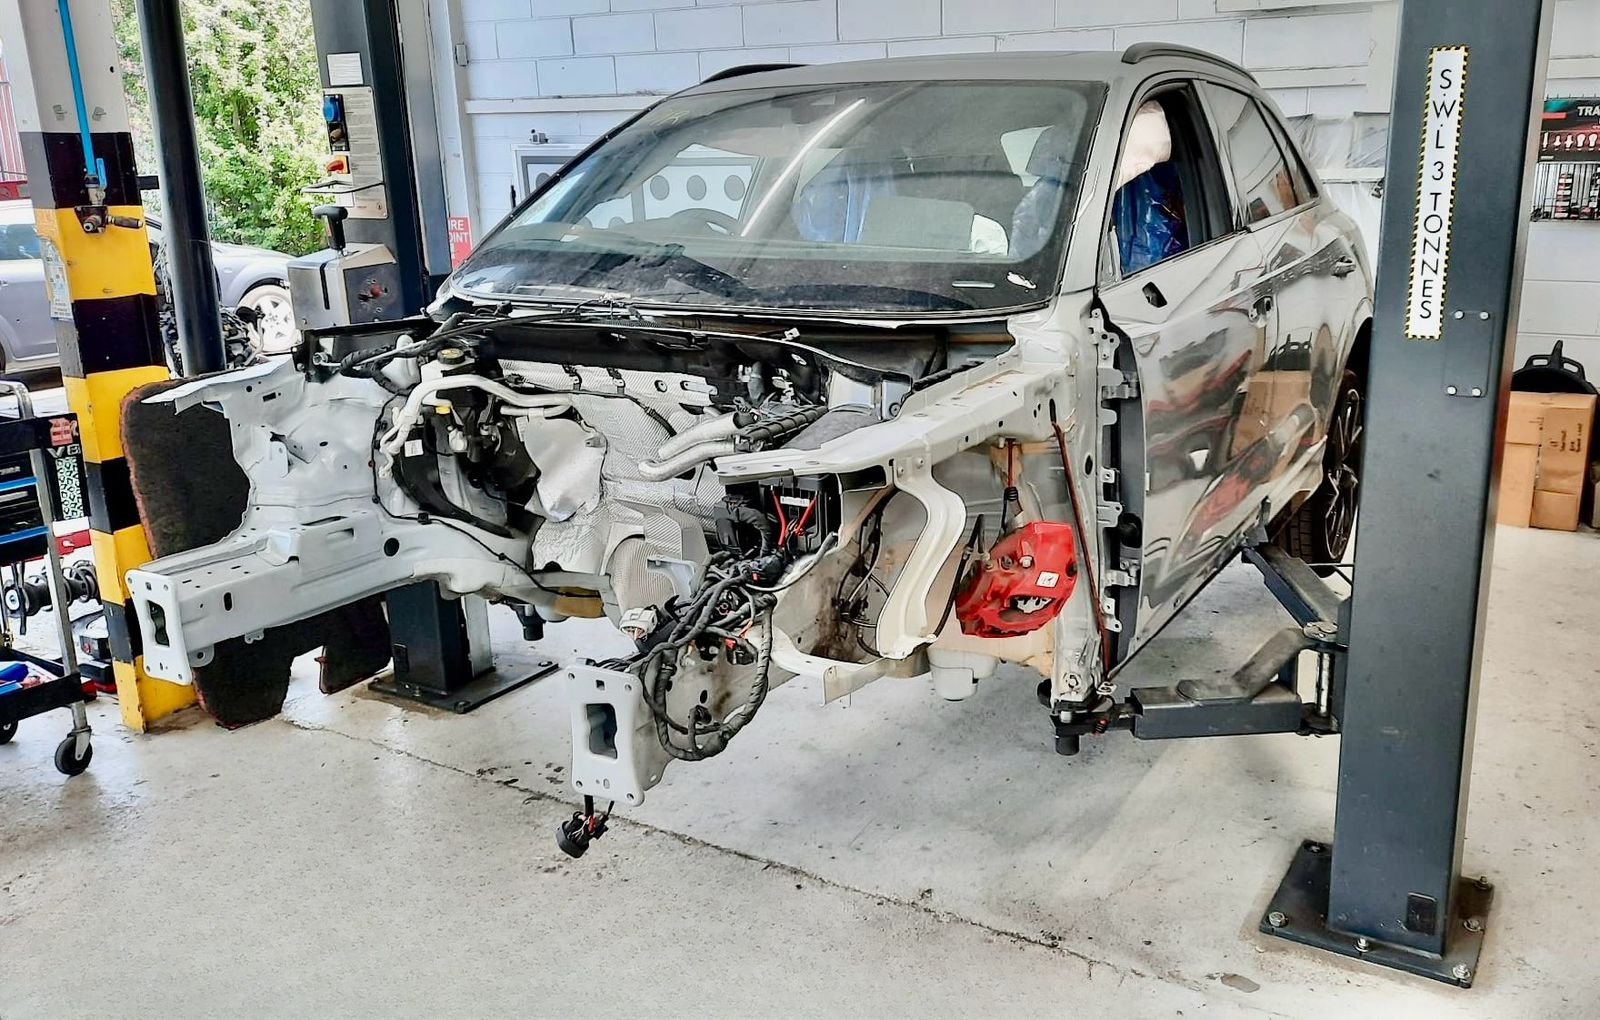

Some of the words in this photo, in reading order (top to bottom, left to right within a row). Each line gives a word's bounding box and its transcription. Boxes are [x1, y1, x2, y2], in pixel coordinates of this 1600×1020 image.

[1577, 106, 1600, 116] TRA
[1431, 161, 1444, 181] 3
[449, 231, 469, 243] OINT
[1419, 192, 1443, 319] TONNES
